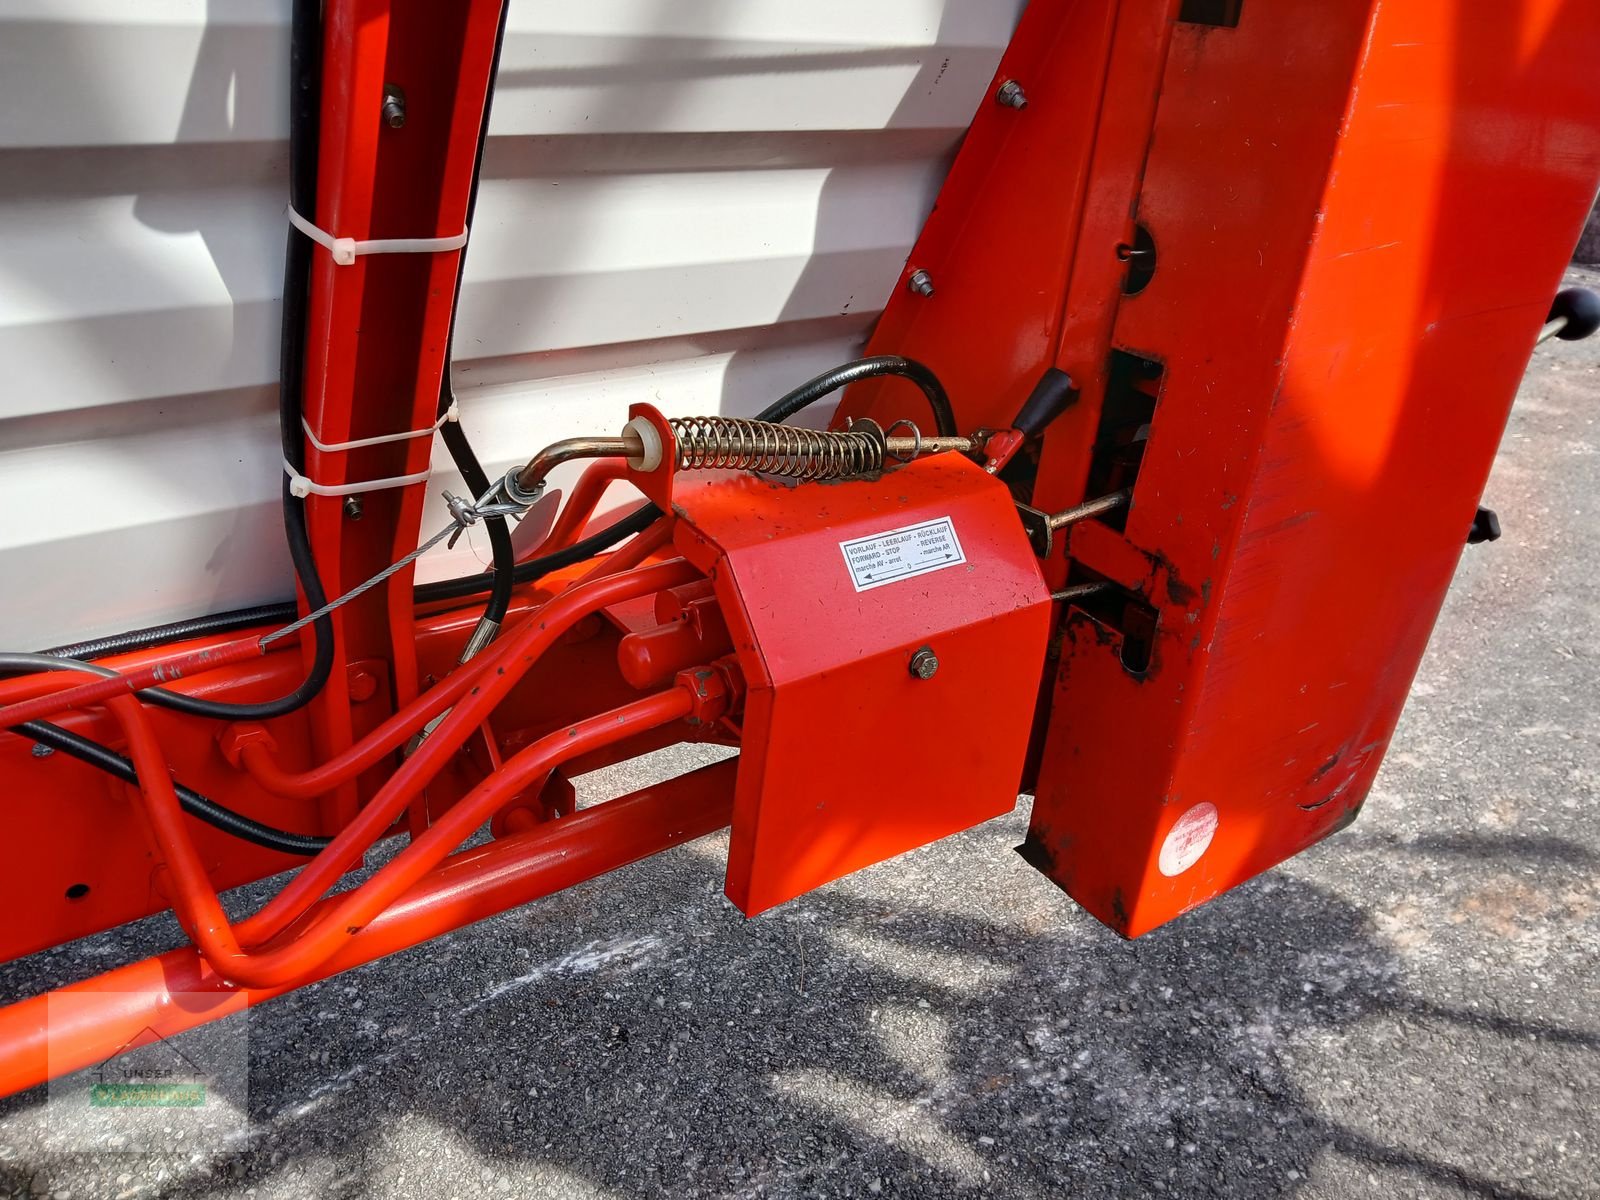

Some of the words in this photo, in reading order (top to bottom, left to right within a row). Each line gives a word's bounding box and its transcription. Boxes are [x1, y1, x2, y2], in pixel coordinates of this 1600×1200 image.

[849, 544, 877, 555] VORLAUF
[882, 535, 912, 547] LEERLAUF
[917, 526, 948, 538] RÜCKLAUF
[852, 552, 881, 564] FORWARD
[885, 547, 900, 555] STOP
[920, 535, 946, 546] REVERSE
[856, 563, 876, 573] marche
[923, 546, 942, 555] marche
[943, 543, 951, 551] AR
